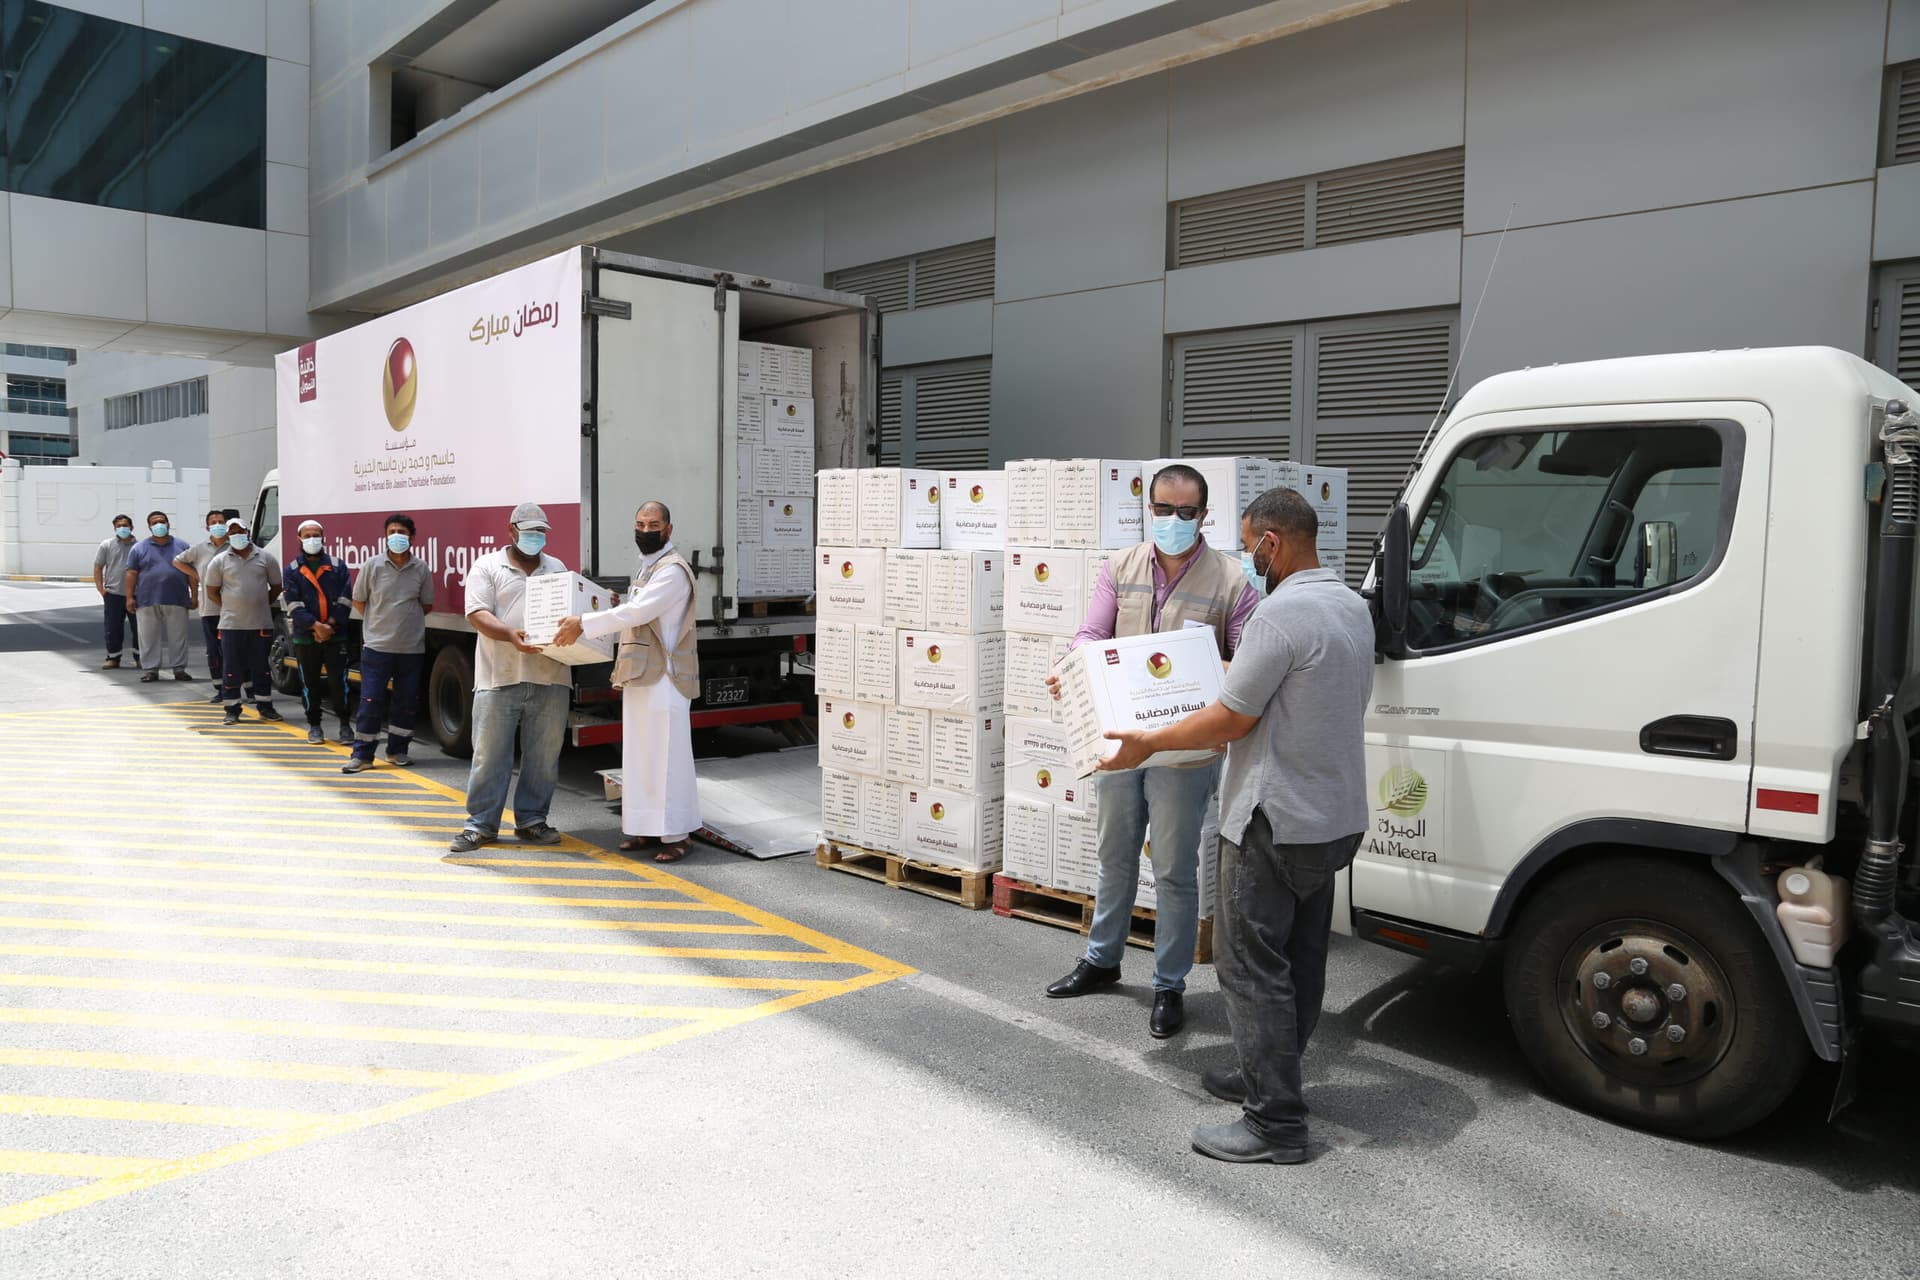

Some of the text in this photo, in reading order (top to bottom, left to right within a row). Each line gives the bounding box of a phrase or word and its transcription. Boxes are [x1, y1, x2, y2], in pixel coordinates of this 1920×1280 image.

[469, 300, 559, 346] رمضان مبارك
[385, 436, 416, 451] مؤسسة
[430, 474, 456, 486] Foundation
[1135, 700, 1207, 721] السلة الرمضانية
[1374, 704, 1440, 715] CANTER
[1378, 818, 1426, 839] الميرة
[1368, 838, 1438, 863] Al Meera
